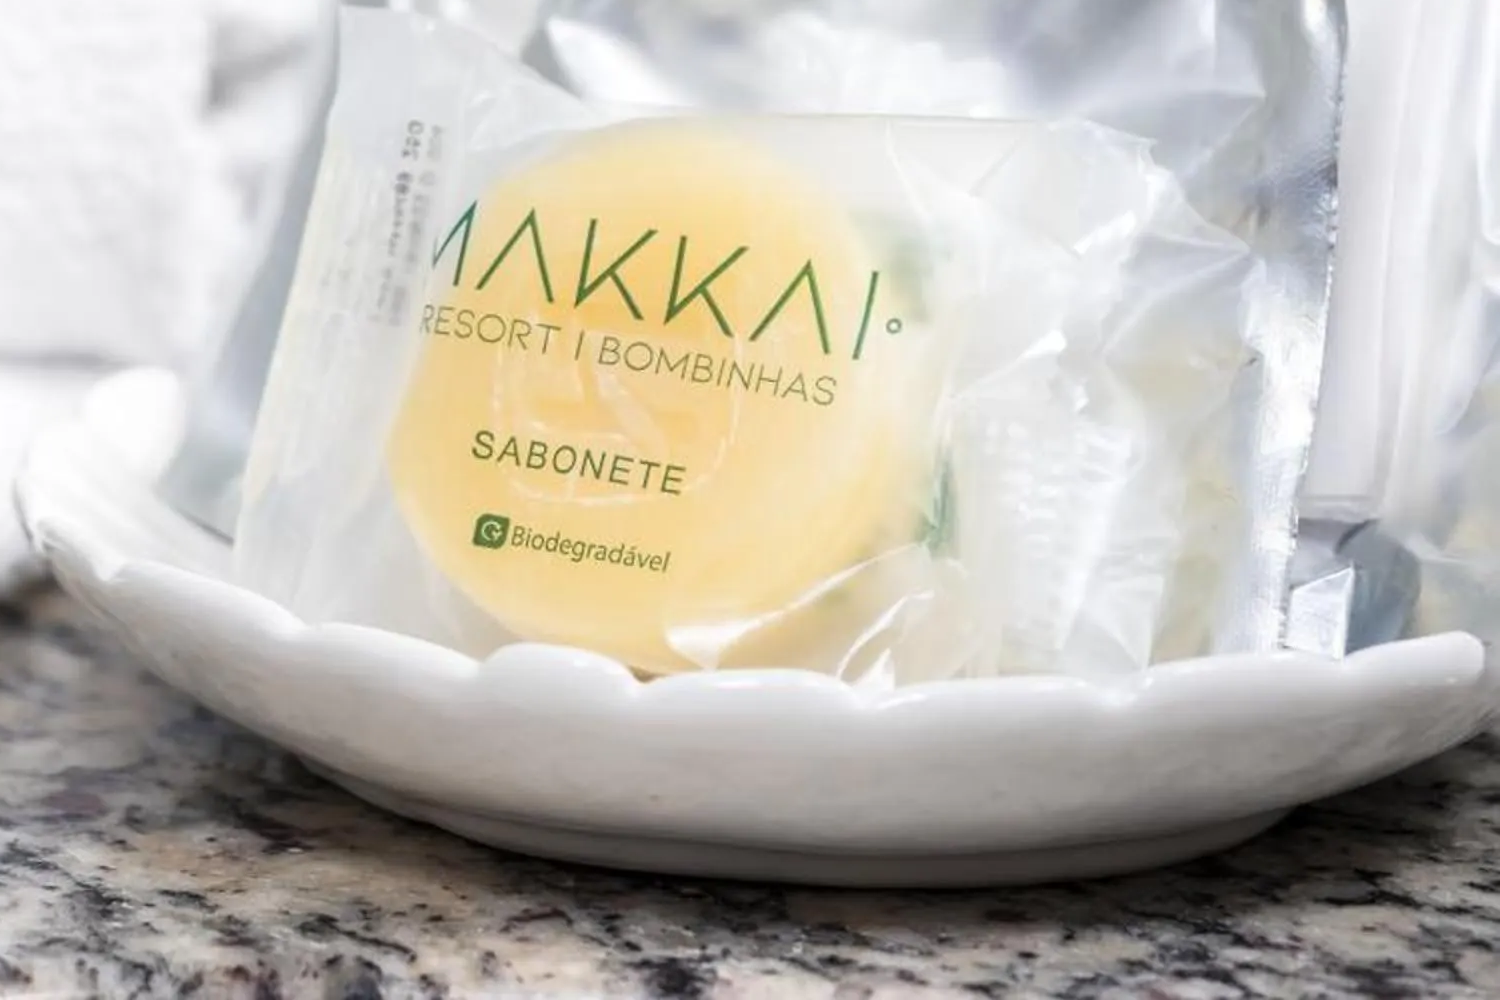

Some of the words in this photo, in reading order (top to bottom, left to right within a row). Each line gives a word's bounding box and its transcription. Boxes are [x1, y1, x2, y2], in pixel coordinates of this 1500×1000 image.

[419, 303, 561, 354] RESORT
[598, 335, 838, 406] BOMBINHAS
[471, 430, 687, 495] SABONETE
[510, 525, 671, 573] Biodegradável
